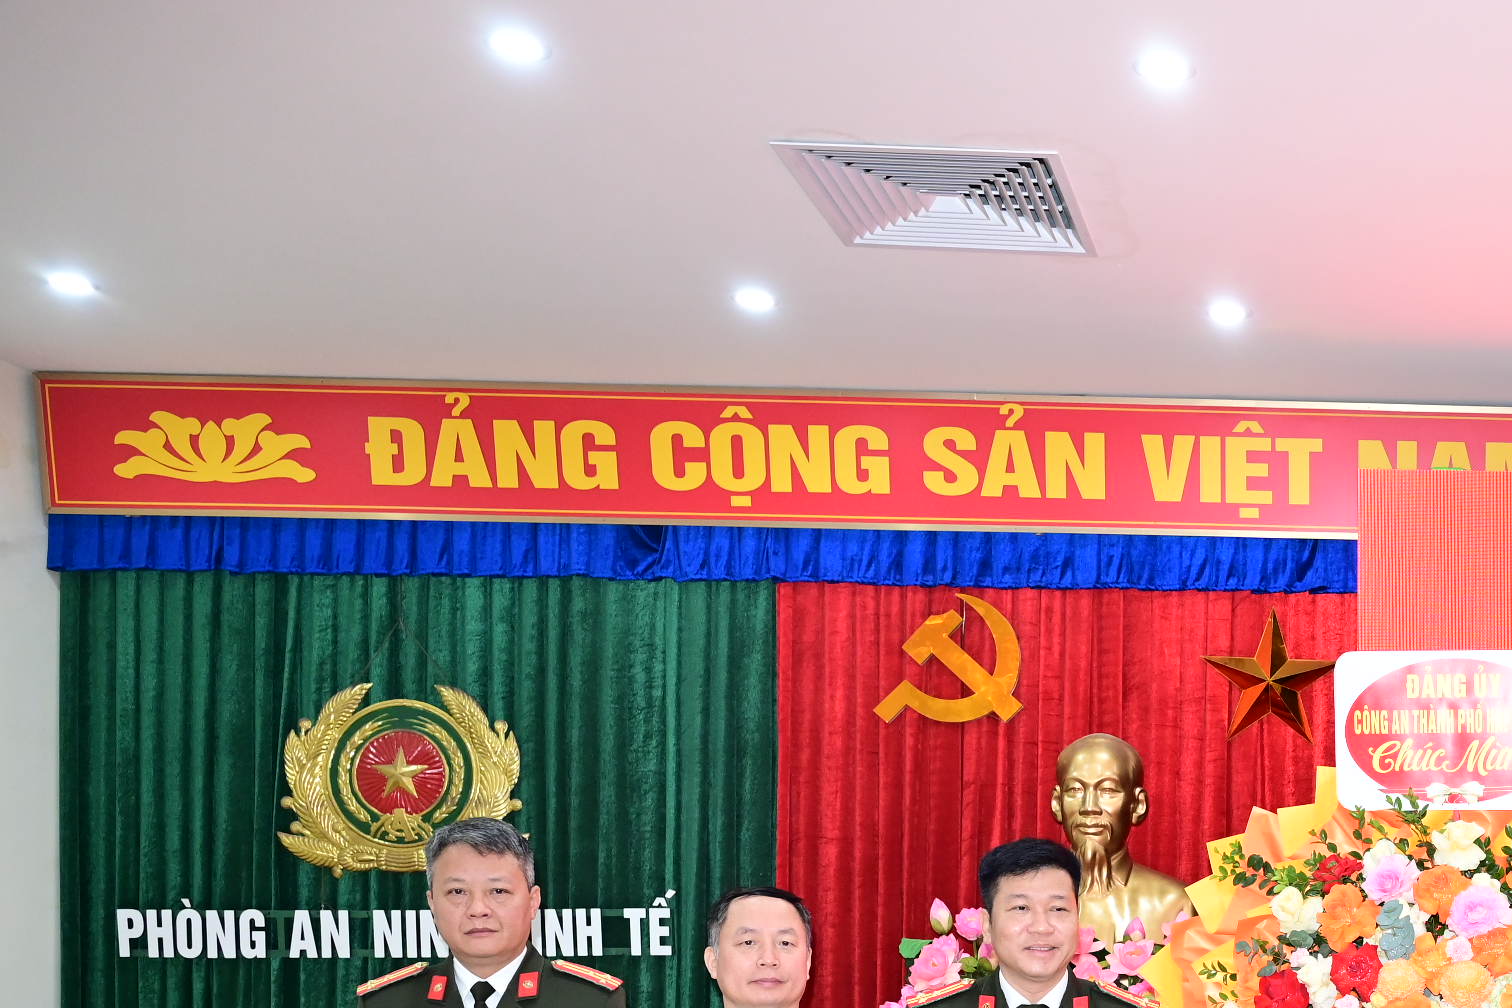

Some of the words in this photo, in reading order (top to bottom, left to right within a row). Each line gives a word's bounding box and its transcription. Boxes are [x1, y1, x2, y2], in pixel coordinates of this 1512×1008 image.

[365, 391, 621, 490] ĐẢNG
[649, 405, 891, 507] CỘNG
[922, 403, 1106, 500] SẢN
[1142, 421, 1323, 518] VIỆT
[1405, 666, 1467, 699] ĐẢNG
[1353, 705, 1390, 735] CÔNG
[1392, 710, 1410, 735] AN
[1413, 703, 1455, 734] THÀNH
[1457, 701, 1484, 734] PHỐ
[1368, 738, 1449, 774] Chúc
[116, 898, 266, 959] PHÒNG
[289, 908, 351, 959] AN
[372, 909, 450, 959] NIN
[531, 907, 604, 958] INH
[623, 889, 677, 957] TẾ
